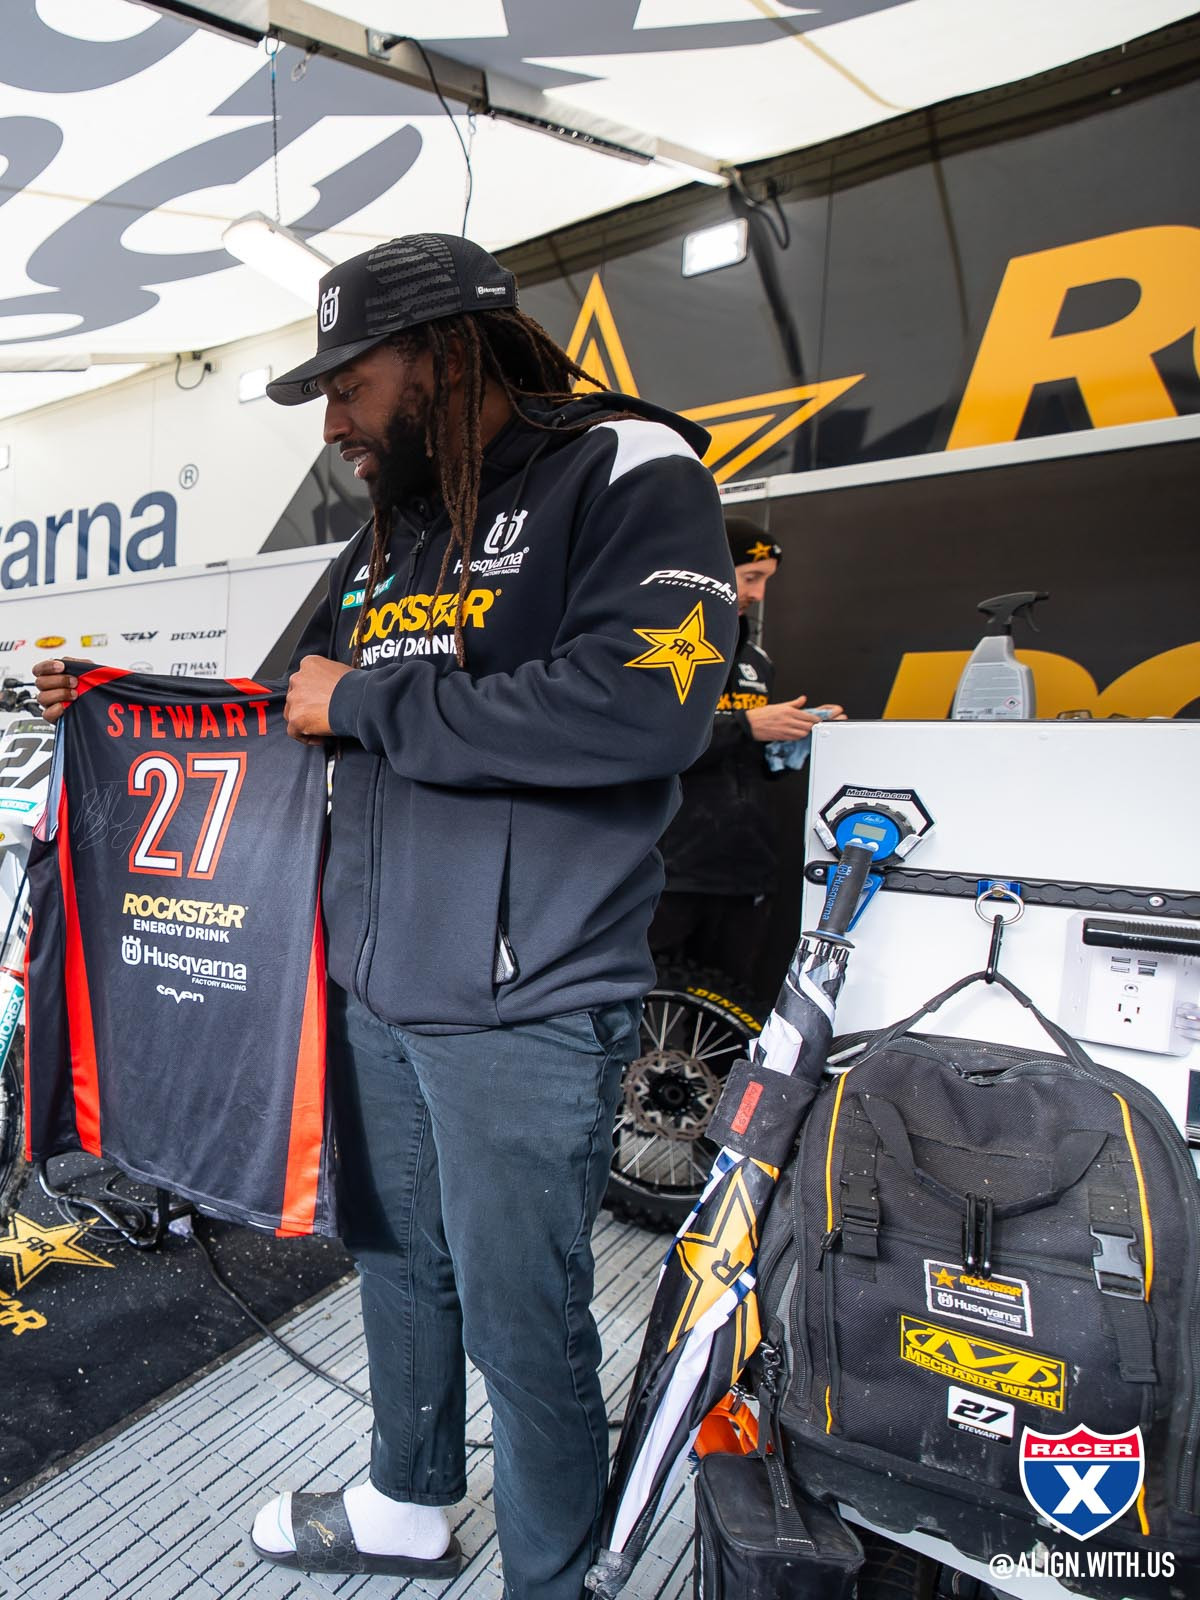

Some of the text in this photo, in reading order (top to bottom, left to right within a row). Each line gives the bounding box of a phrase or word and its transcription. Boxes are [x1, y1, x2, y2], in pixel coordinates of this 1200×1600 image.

[170, 629, 227, 641] DUNLOP
[107, 700, 271, 739] STEWART
[127, 751, 247, 880] 27
[122, 892, 246, 929] ROCKSTAR
[133, 918, 231, 943] ENERGY DRINK
[143, 944, 247, 981] Husqvarna
[191, 977, 247, 991] FACTORY RACING
[693, 986, 762, 1032] DUNLOP
[954, 1298, 1022, 1324] Husqvarna
[906, 1345, 1058, 1408] MECHANIX WEAR
[952, 1399, 1009, 1425] 27
[958, 1423, 1002, 1442] STEWART
